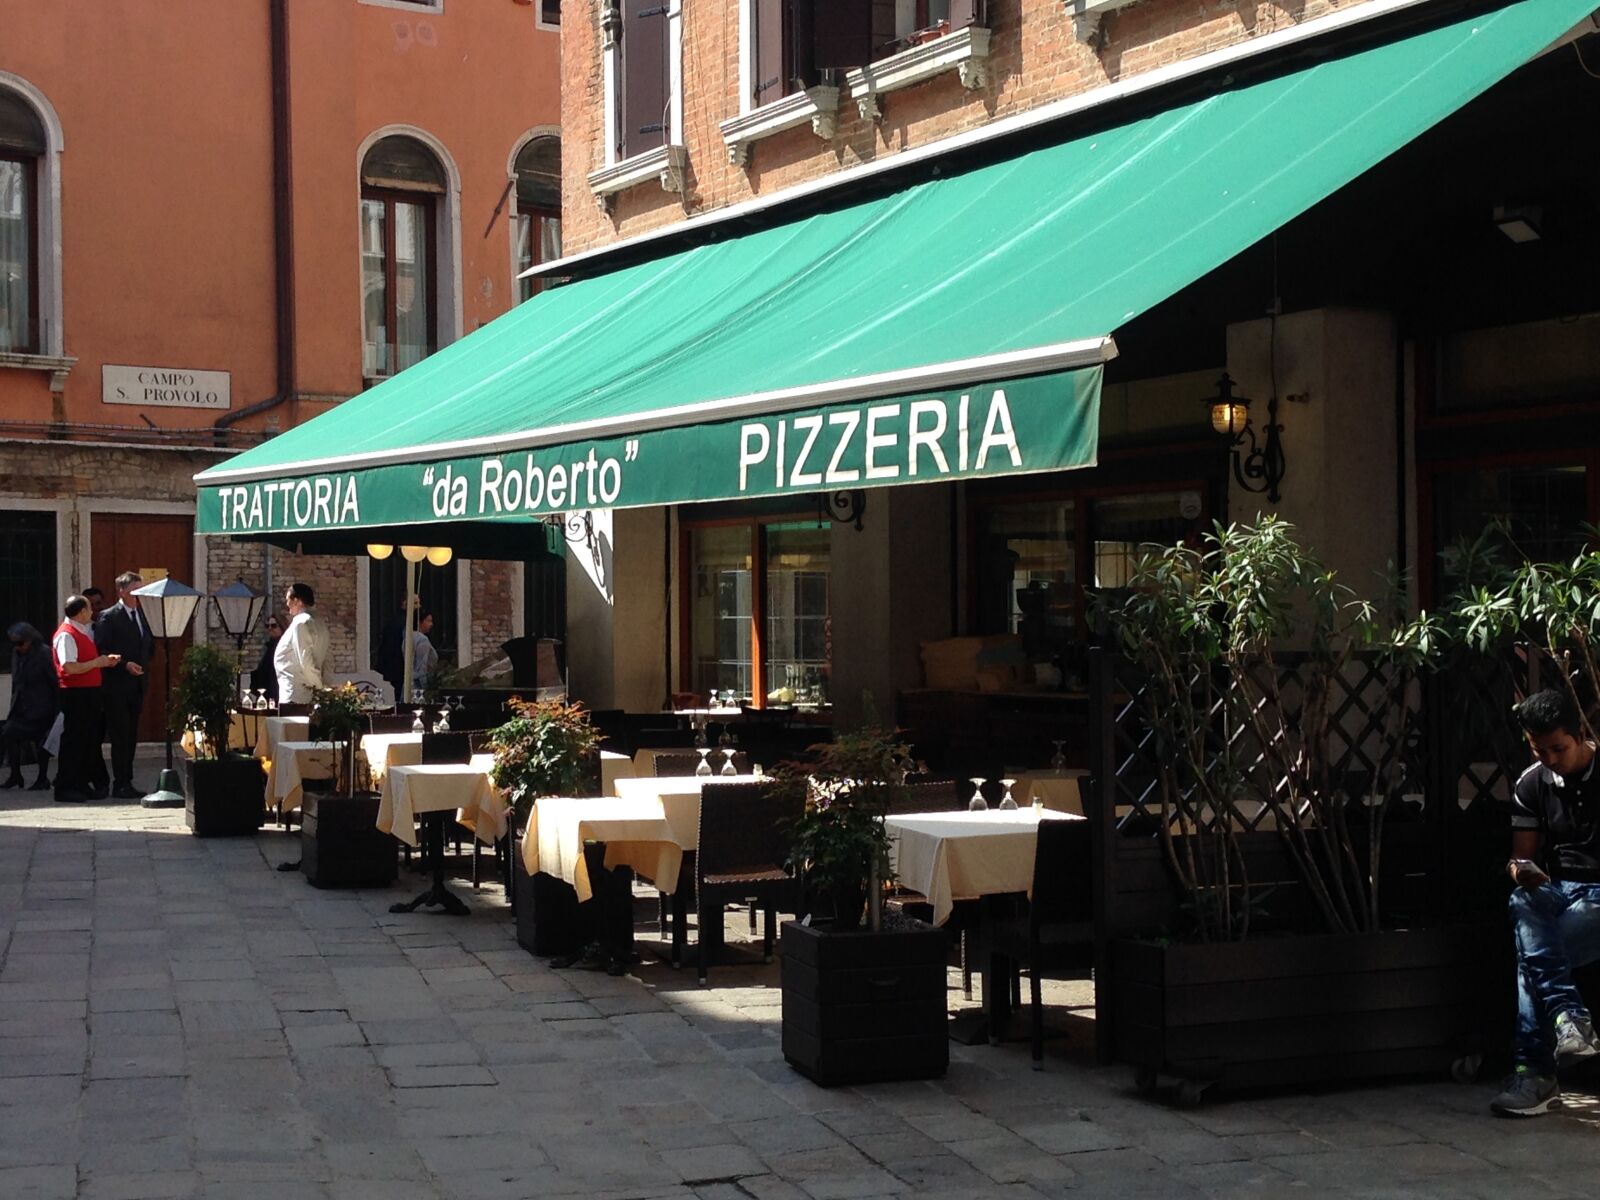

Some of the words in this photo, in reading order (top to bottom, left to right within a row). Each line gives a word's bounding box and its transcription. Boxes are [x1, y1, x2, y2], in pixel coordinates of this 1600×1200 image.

[138, 372, 194, 386] CAMPO
[116, 387, 130, 399] S.
[144, 388, 217, 403] PROVOLO
[218, 475, 360, 530] TRATTORIA
[422, 466, 467, 518] “da
[479, 439, 640, 514] Roberto”
[739, 389, 1023, 491] PIZZERIA
